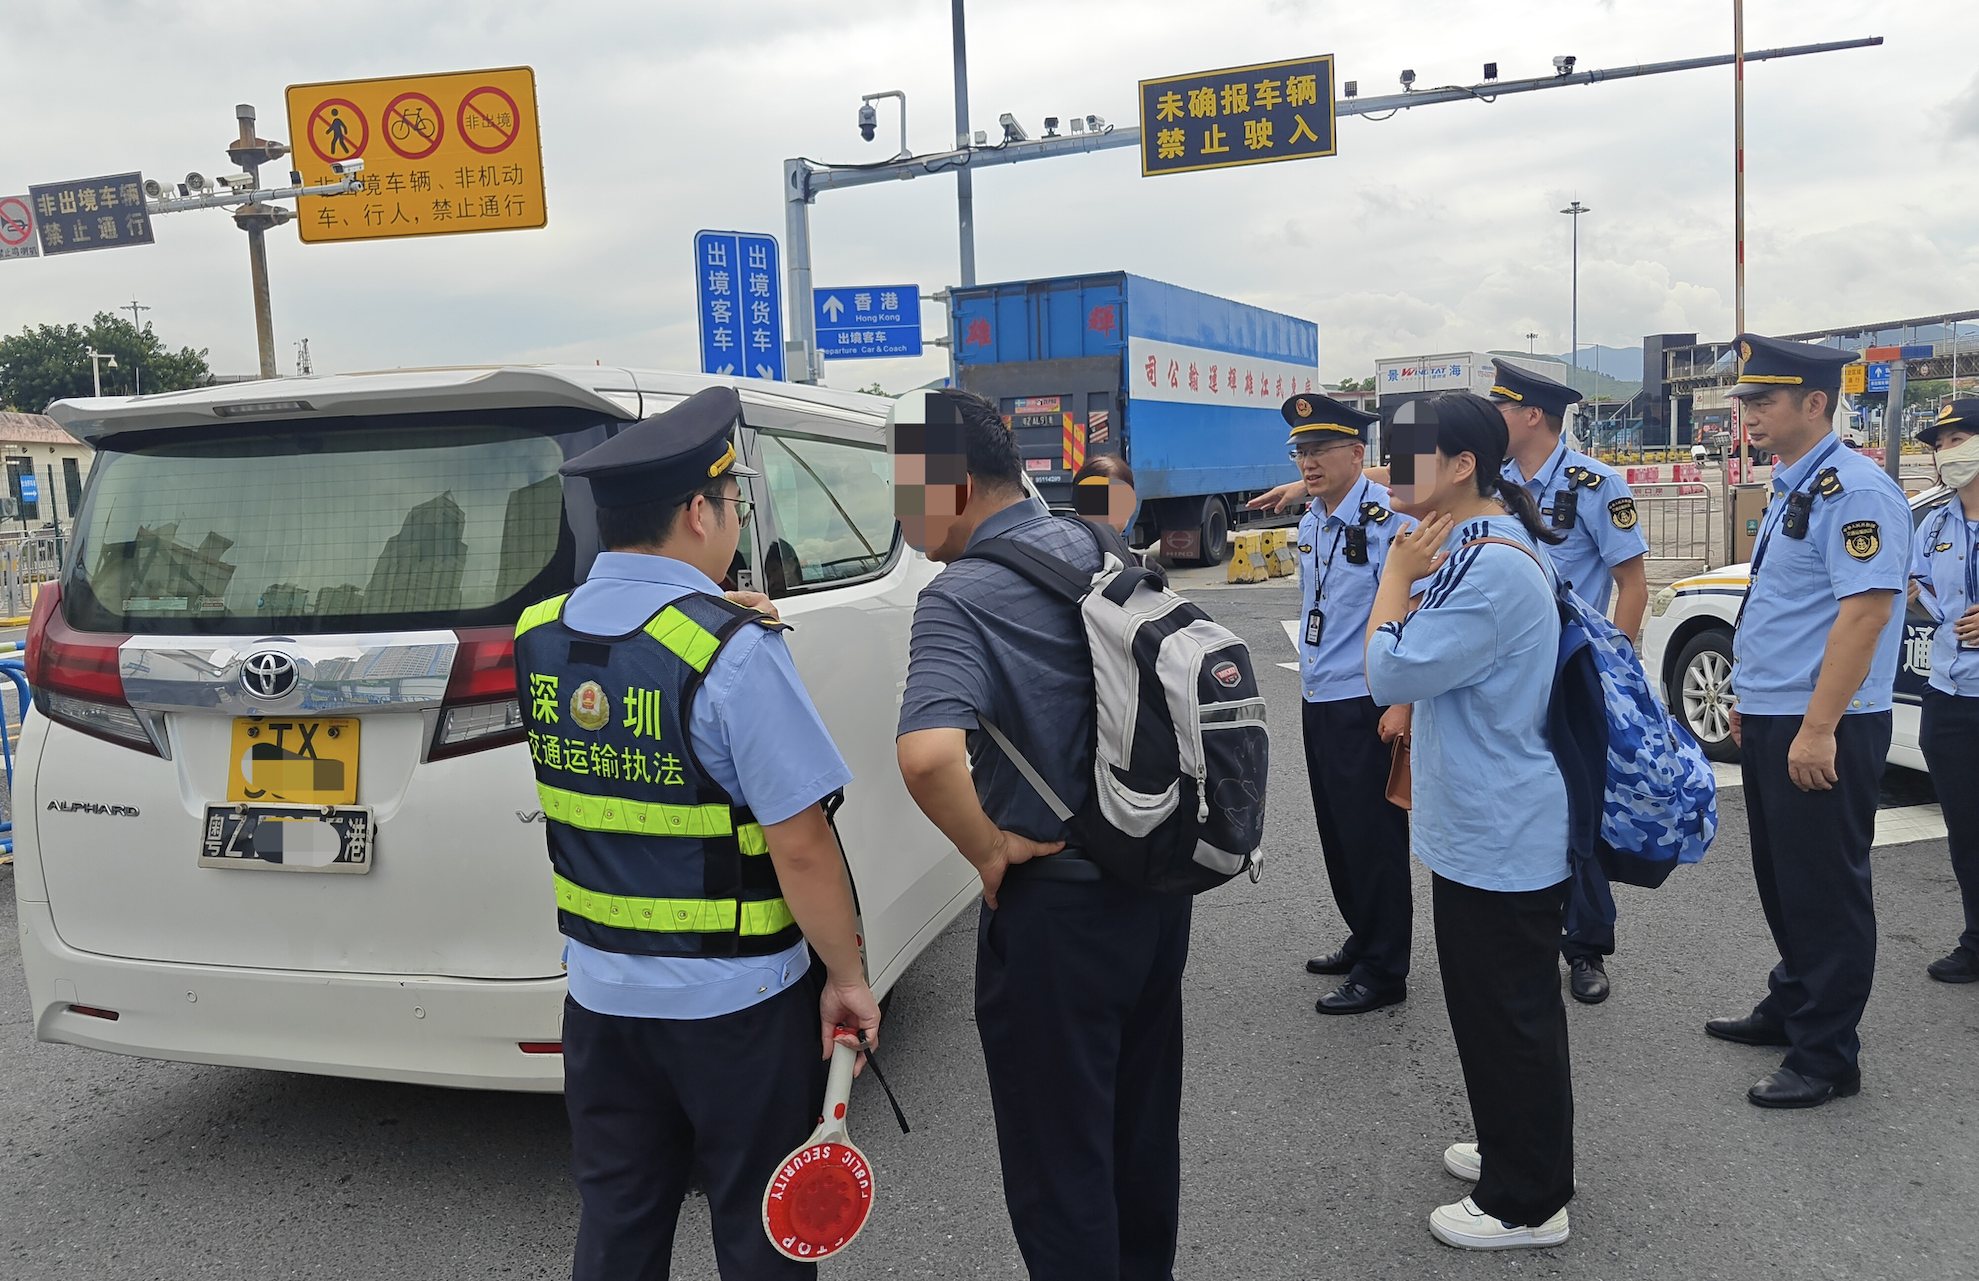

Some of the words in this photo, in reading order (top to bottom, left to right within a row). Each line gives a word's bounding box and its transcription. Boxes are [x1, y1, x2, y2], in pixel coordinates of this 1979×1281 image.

[1156, 74, 1317, 122] 未确报车辆
[465, 112, 512, 130] 非出境
[1157, 113, 1319, 159] 禁止驶入
[36, 182, 141, 217] 非出境车辆
[43, 212, 145, 247] 禁止通行
[706, 241, 735, 353] 出境客车
[748, 244, 773, 353] 出境货车
[854, 291, 899, 312] 香港
[855, 315, 878, 323] Hong
[878, 314, 901, 322] Kong
[824, 347, 858, 356] eparture
[861, 346, 875, 354] Car
[883, 345, 908, 353] Coach
[838, 331, 887, 345] 出境客车
[1388, 369, 1399, 382] 景
[1449, 364, 1461, 377] 海
[1902, 624, 1935, 677] 通
[527, 729, 685, 786] 交通运输执法
[46, 799, 141, 817] ALPHARD
[771, 1146, 831, 1200] SECURITY
